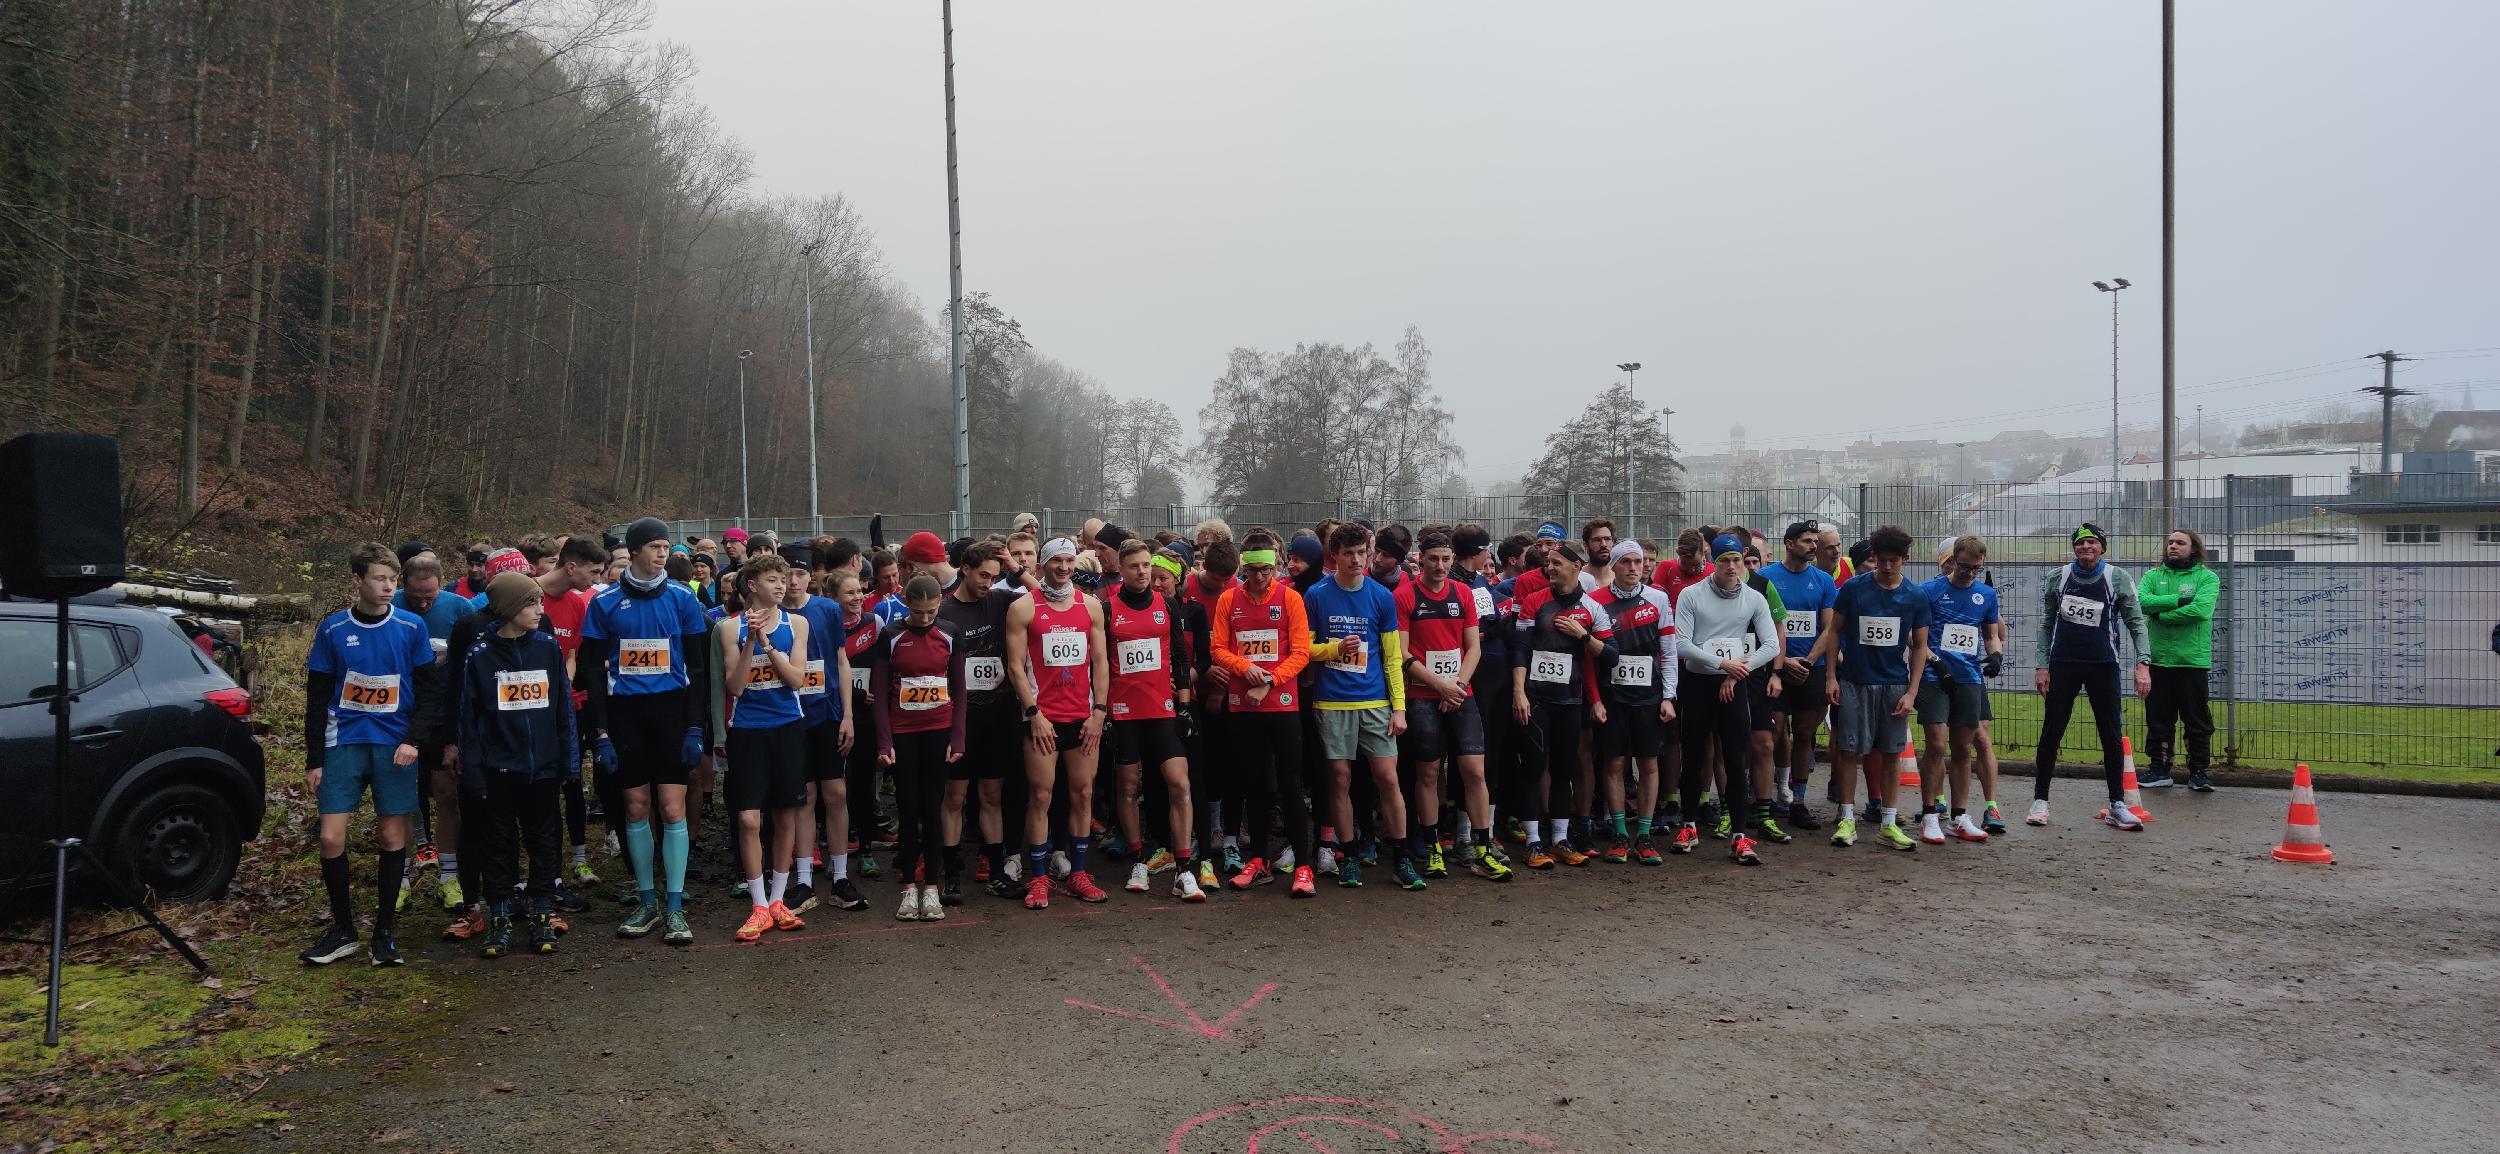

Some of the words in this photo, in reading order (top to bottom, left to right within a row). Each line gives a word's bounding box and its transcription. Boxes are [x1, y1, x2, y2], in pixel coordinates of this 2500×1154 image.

[2067, 605, 2095, 620] 545
[1786, 620, 1811, 632] 678
[1866, 626, 1893, 640] 558
[1242, 640, 1271, 656] 276
[1949, 633, 1974, 648] 325
[627, 650, 658, 667] 241
[1051, 644, 1080, 659] 605
[1126, 649, 1154, 666] 604
[750, 666, 782, 683] 25
[1434, 660, 1458, 675] 552
[1538, 661, 1564, 677] 633
[1618, 665, 1645, 679] 616
[351, 685, 390, 704] 279
[507, 683, 542, 702] 269
[907, 687, 940, 702] 278
